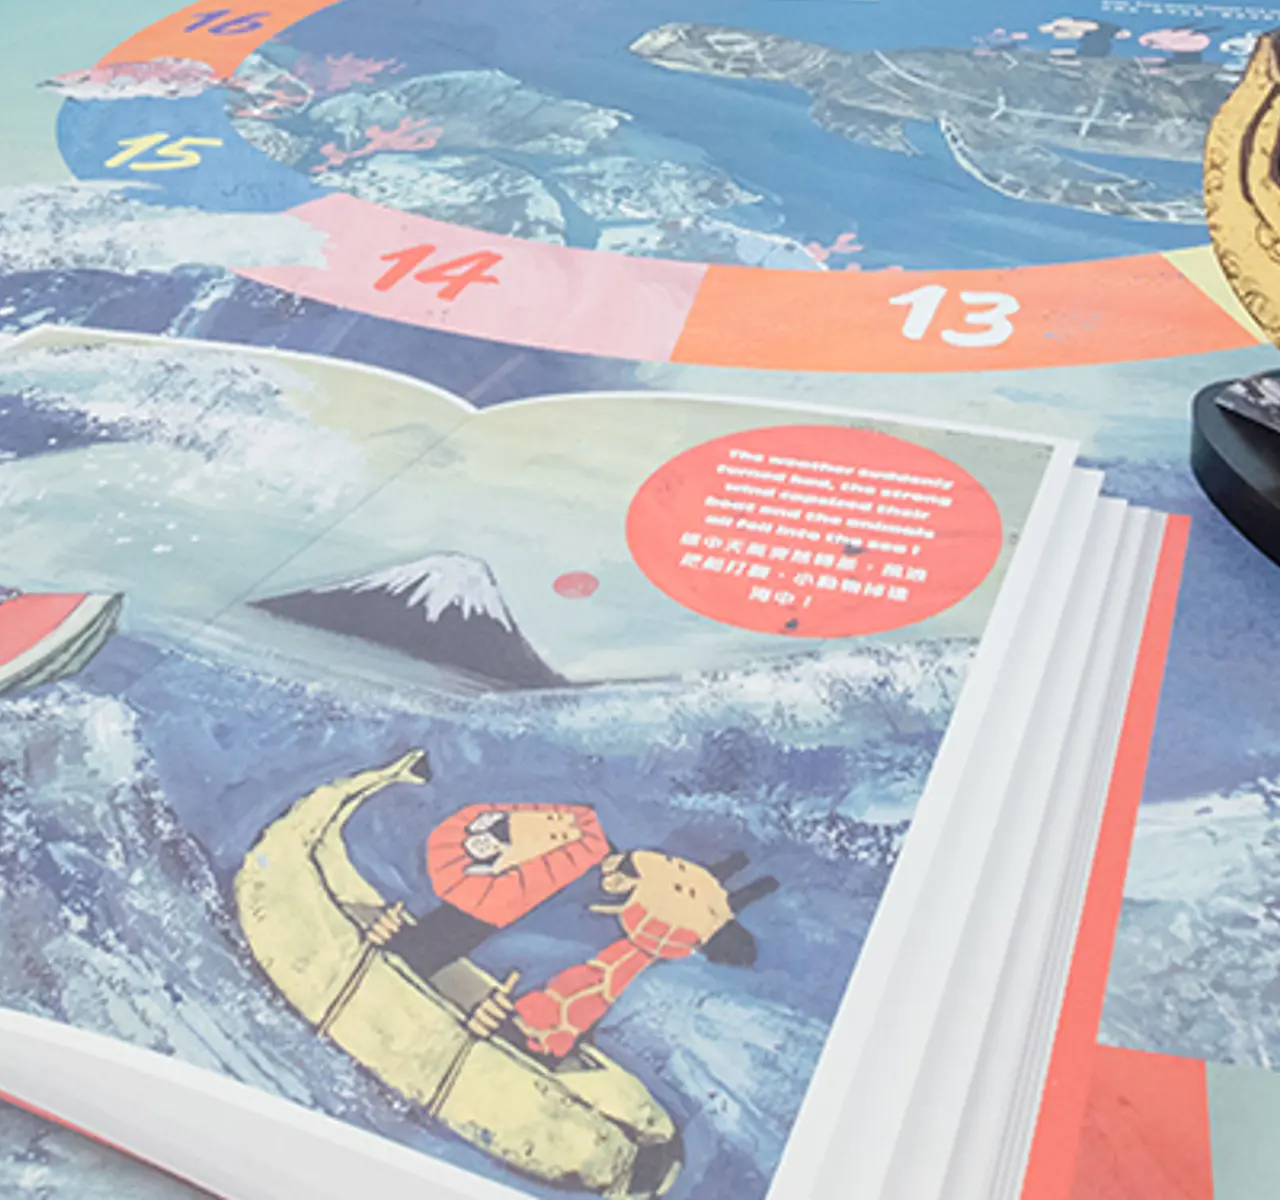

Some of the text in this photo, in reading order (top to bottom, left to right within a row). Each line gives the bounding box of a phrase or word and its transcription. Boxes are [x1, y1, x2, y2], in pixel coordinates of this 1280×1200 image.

[181, 11, 267, 38] 16
[103, 133, 224, 172] 15
[369, 244, 505, 300] 14
[888, 285, 1021, 348] 13
[717, 464, 787, 482] turned
[840, 482, 876, 495] the
[880, 488, 953, 507] strong
[730, 449, 954, 490] The weather suddenly
[704, 496, 936, 539] boat and the animals
[725, 483, 931, 520] wind capsized their
[704, 514, 734, 527] all
[776, 525, 821, 540] into
[826, 532, 863, 546] the
[867, 539, 908, 554] sea
